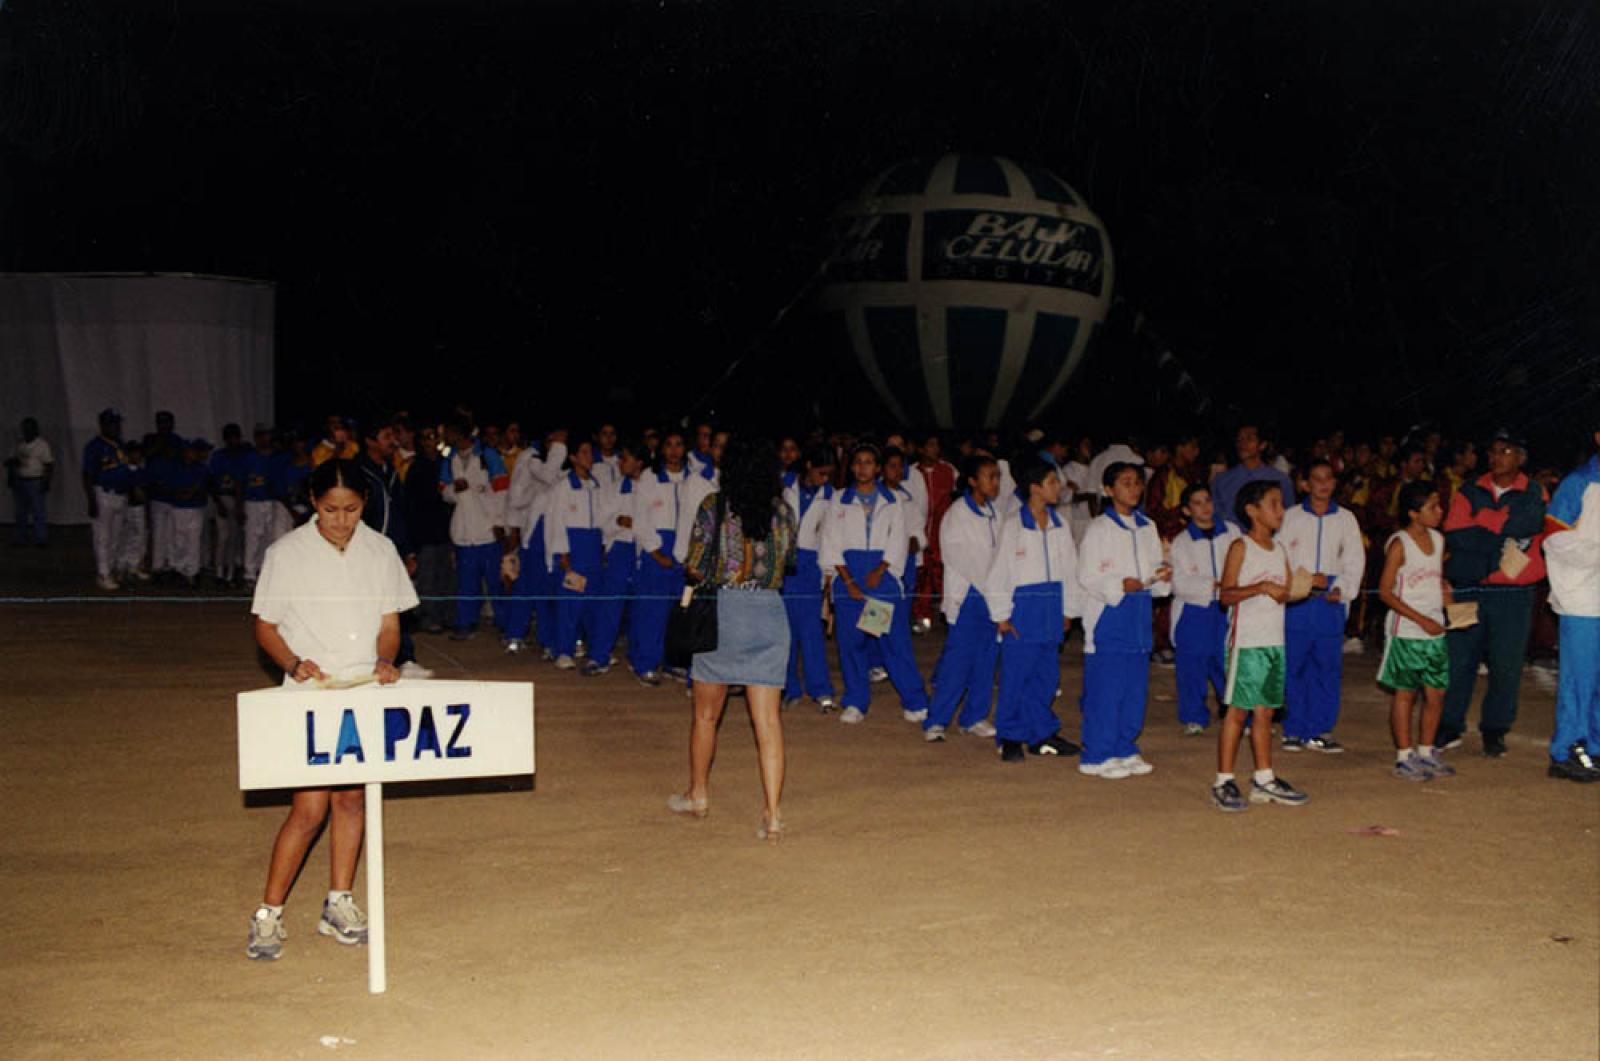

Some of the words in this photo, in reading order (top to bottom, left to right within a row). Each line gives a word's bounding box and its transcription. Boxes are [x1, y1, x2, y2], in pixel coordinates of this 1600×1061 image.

[945, 235, 1093, 272] CELULAR
[307, 709, 364, 765] LA
[383, 704, 471, 761] PAZ
